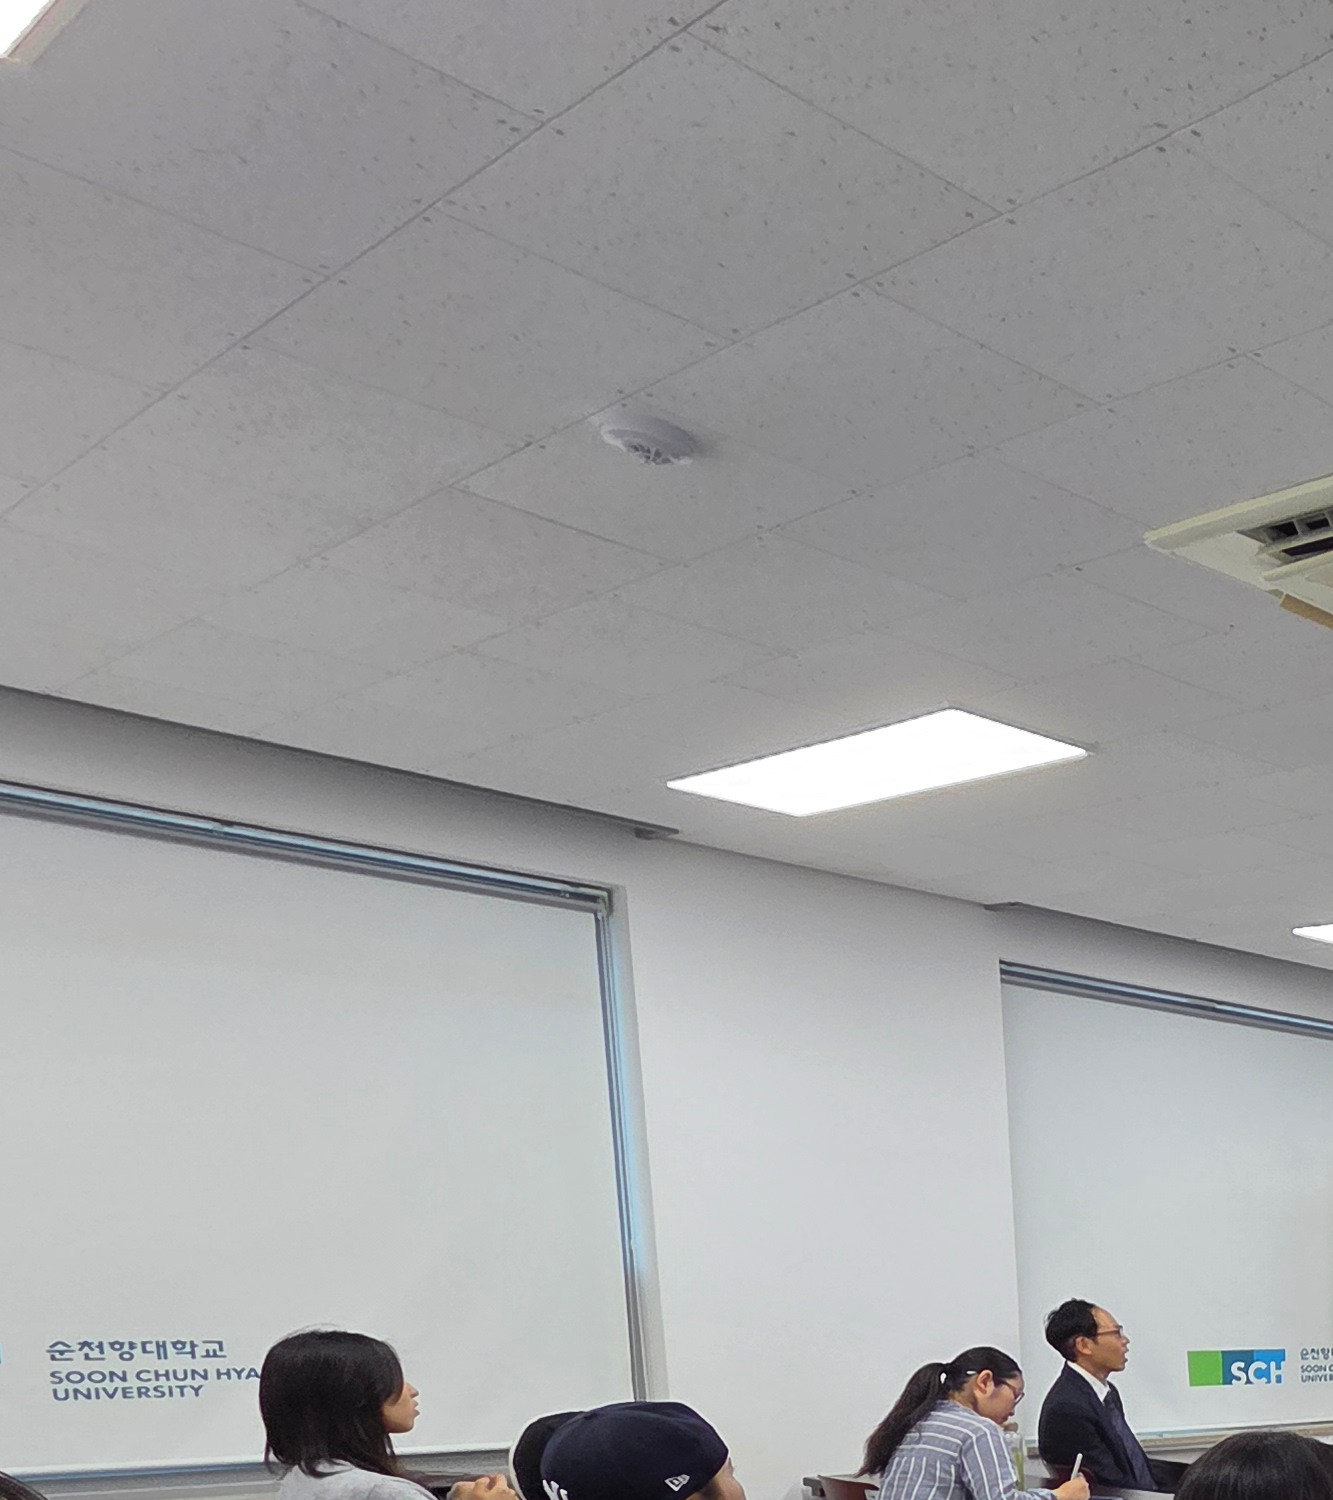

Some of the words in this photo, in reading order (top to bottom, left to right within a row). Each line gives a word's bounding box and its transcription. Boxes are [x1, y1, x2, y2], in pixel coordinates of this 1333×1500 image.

[46, 1339, 227, 1362] 순천향대학교
[50, 1370, 128, 1384] SOON
[135, 1368, 209, 1382] CHUN
[216, 1367, 261, 1381] HYA
[1230, 1361, 1285, 1386] SCH
[1300, 1364, 1327, 1373] SOON
[52, 1384, 204, 1402] UNIVERSITY
